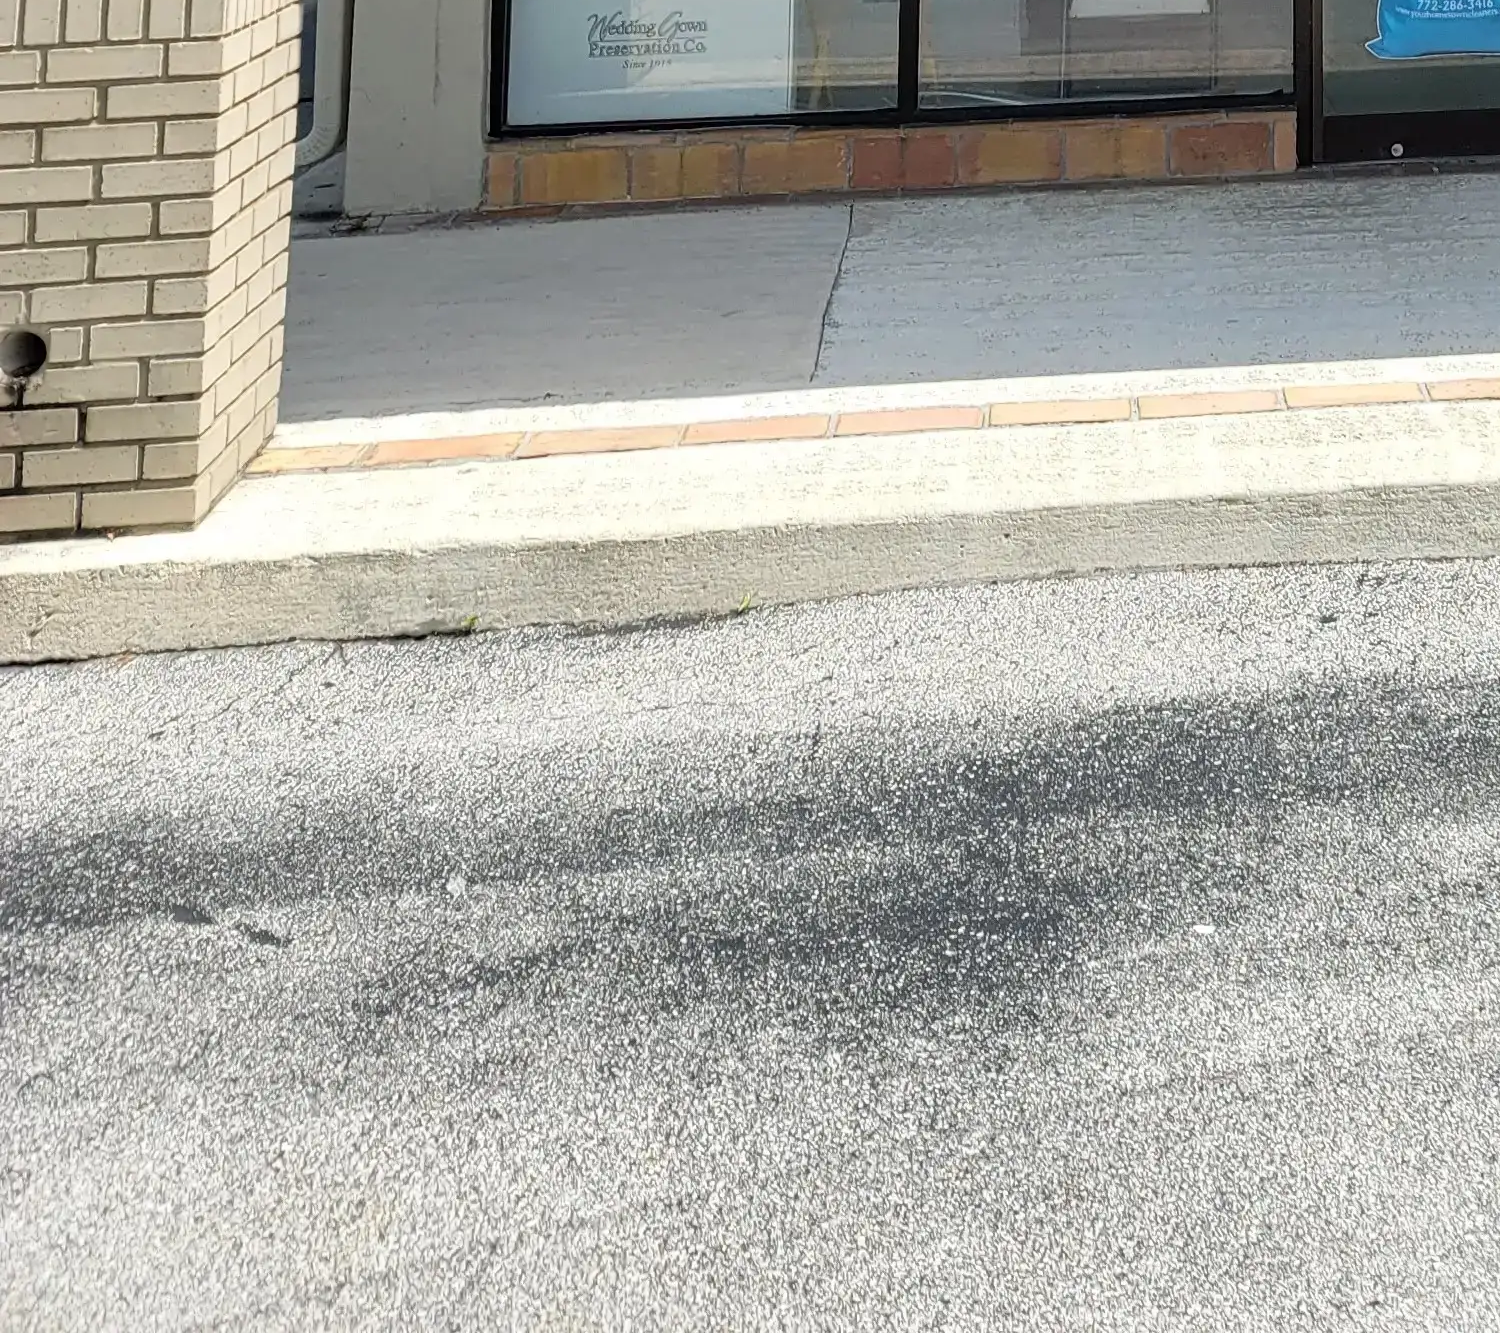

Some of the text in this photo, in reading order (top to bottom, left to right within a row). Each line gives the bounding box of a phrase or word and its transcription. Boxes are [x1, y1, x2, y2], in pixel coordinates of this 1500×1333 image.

[587, 10, 708, 44] Wedding Gown
[588, 38, 680, 57] Preservation
